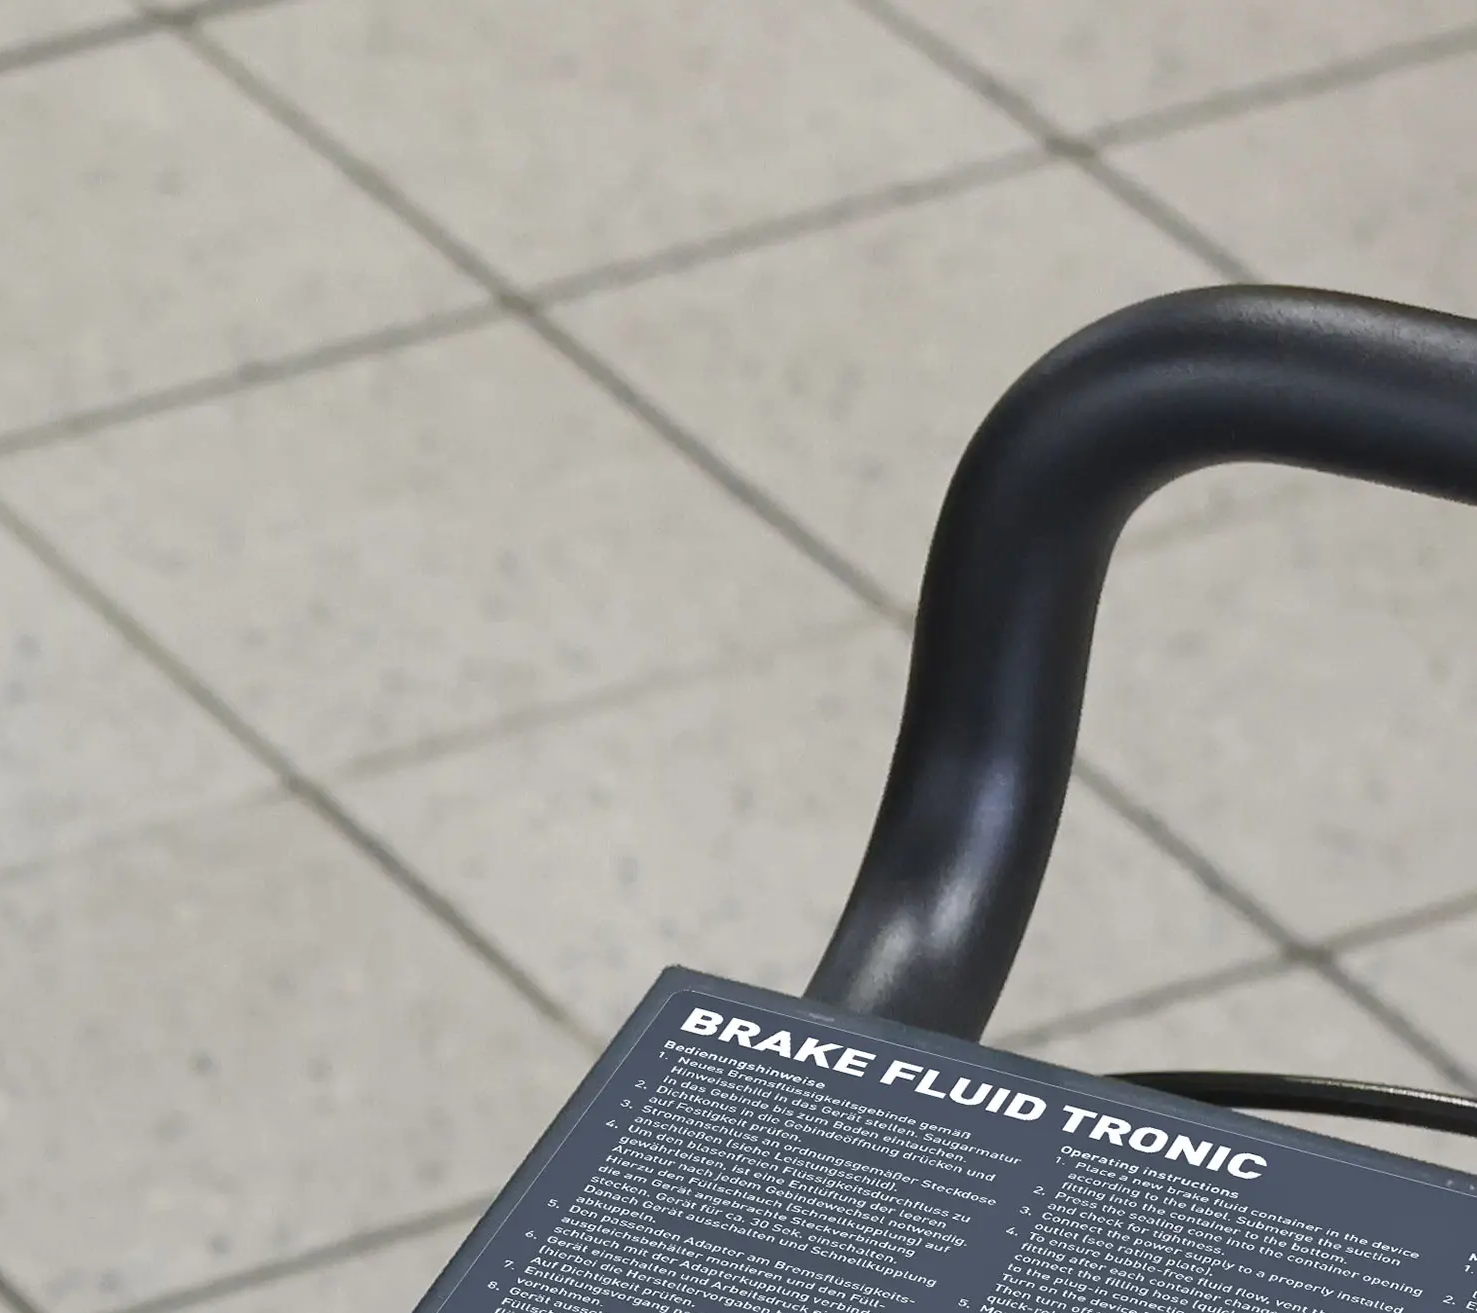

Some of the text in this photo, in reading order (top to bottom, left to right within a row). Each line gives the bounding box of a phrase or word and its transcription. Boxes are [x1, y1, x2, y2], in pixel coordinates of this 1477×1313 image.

[658, 1050, 669, 1060] 1.
[677, 1056, 725, 1075] Neues
[681, 1008, 1267, 1179] BRAKE FLUID TRONIC
[662, 1074, 967, 1163] in das Gebinde bis zum Boden eintauchen.
[597, 1165, 621, 1177] die
[623, 1172, 648, 1184] am
[694, 1191, 788, 1222] angebrachte
[1060, 1145, 1239, 1199] Operating instructions
[583, 1183, 639, 1206] Danach
[685, 1213, 776, 1243] ausschalten
[778, 1238, 809, 1252] und
[1055, 1155, 1420, 1260] 1. Place a new brake fluid container in the device
[524, 1230, 538, 1240] 6.
[590, 1249, 677, 1278] einschalten
[680, 1273, 711, 1286] und
[710, 1281, 810, 1313] Arbeitsdruck
[1002, 1272, 1036, 1289] Turn
[1038, 1285, 1058, 1295] on
[1061, 1289, 1087, 1303] the
[1464, 1264, 1474, 1275] 1.
